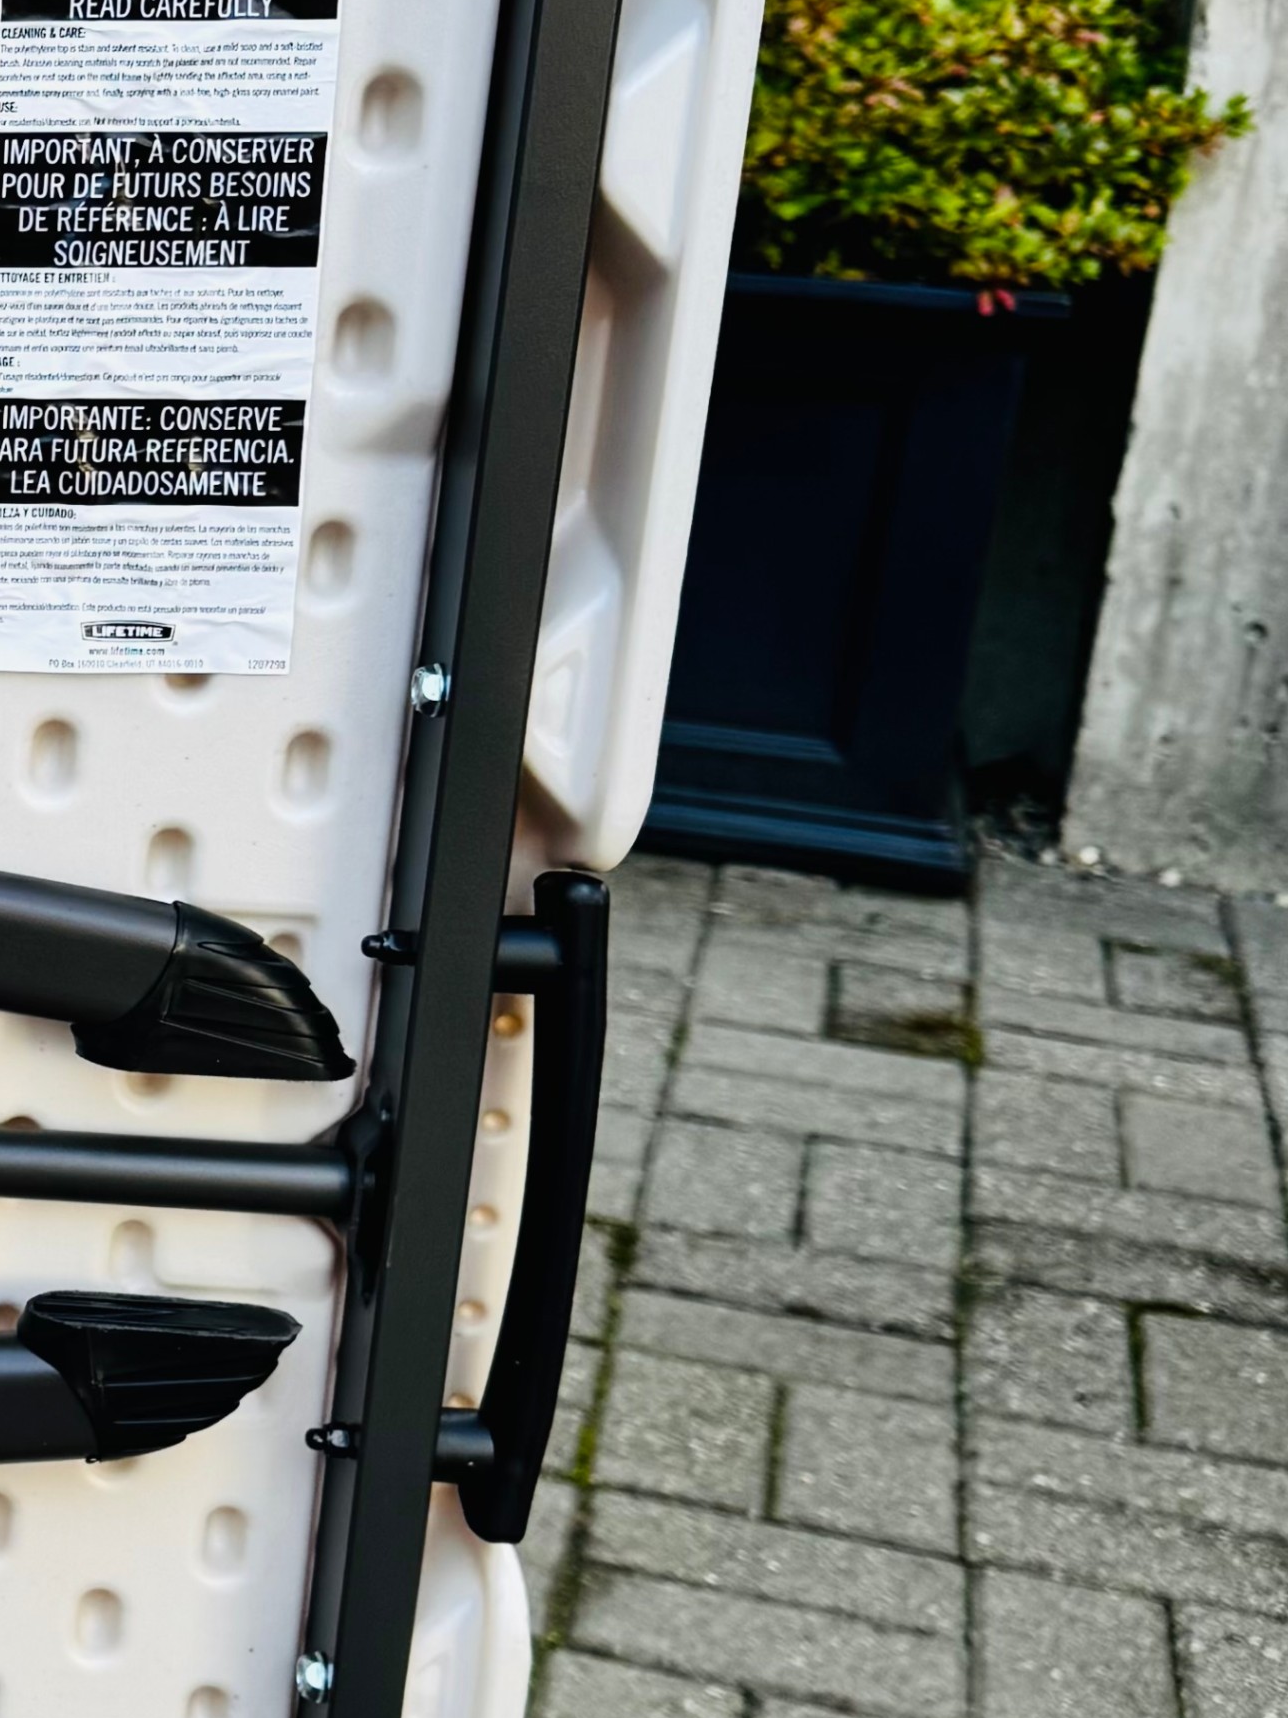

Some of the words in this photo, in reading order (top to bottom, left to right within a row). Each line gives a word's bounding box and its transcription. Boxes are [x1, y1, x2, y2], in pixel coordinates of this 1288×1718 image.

[1, 28, 46, 39] CLEANING
[3, 138, 140, 168] IMPORTANT,
[148, 134, 163, 164] À
[173, 138, 314, 164] CONSERVER
[2, 173, 64, 199] POUR
[74, 173, 105, 198] DE
[112, 172, 201, 198] FUTURS
[209, 172, 311, 198] BESOINS
[18, 207, 48, 232] DE
[57, 203, 193, 232] RÉFÉRENCE
[215, 200, 229, 231] À
[238, 206, 290, 231] LIRE
[54, 240, 250, 266] SOIGNEUSEMENT
[44, 273, 55, 283] ET
[3, 405, 151, 431] IMPORTANTE:
[160, 406, 282, 431] CONSERVE
[51, 438, 137, 463] FUTURA
[146, 438, 294, 464] REFERENCIA.
[10, 471, 50, 494] LEA
[58, 471, 267, 496] CUIDADOSAMENTE
[23, 508, 29, 518] Y
[92, 625, 163, 637] LIFETIME
[89, 647, 165, 656] www.lifetime.com
